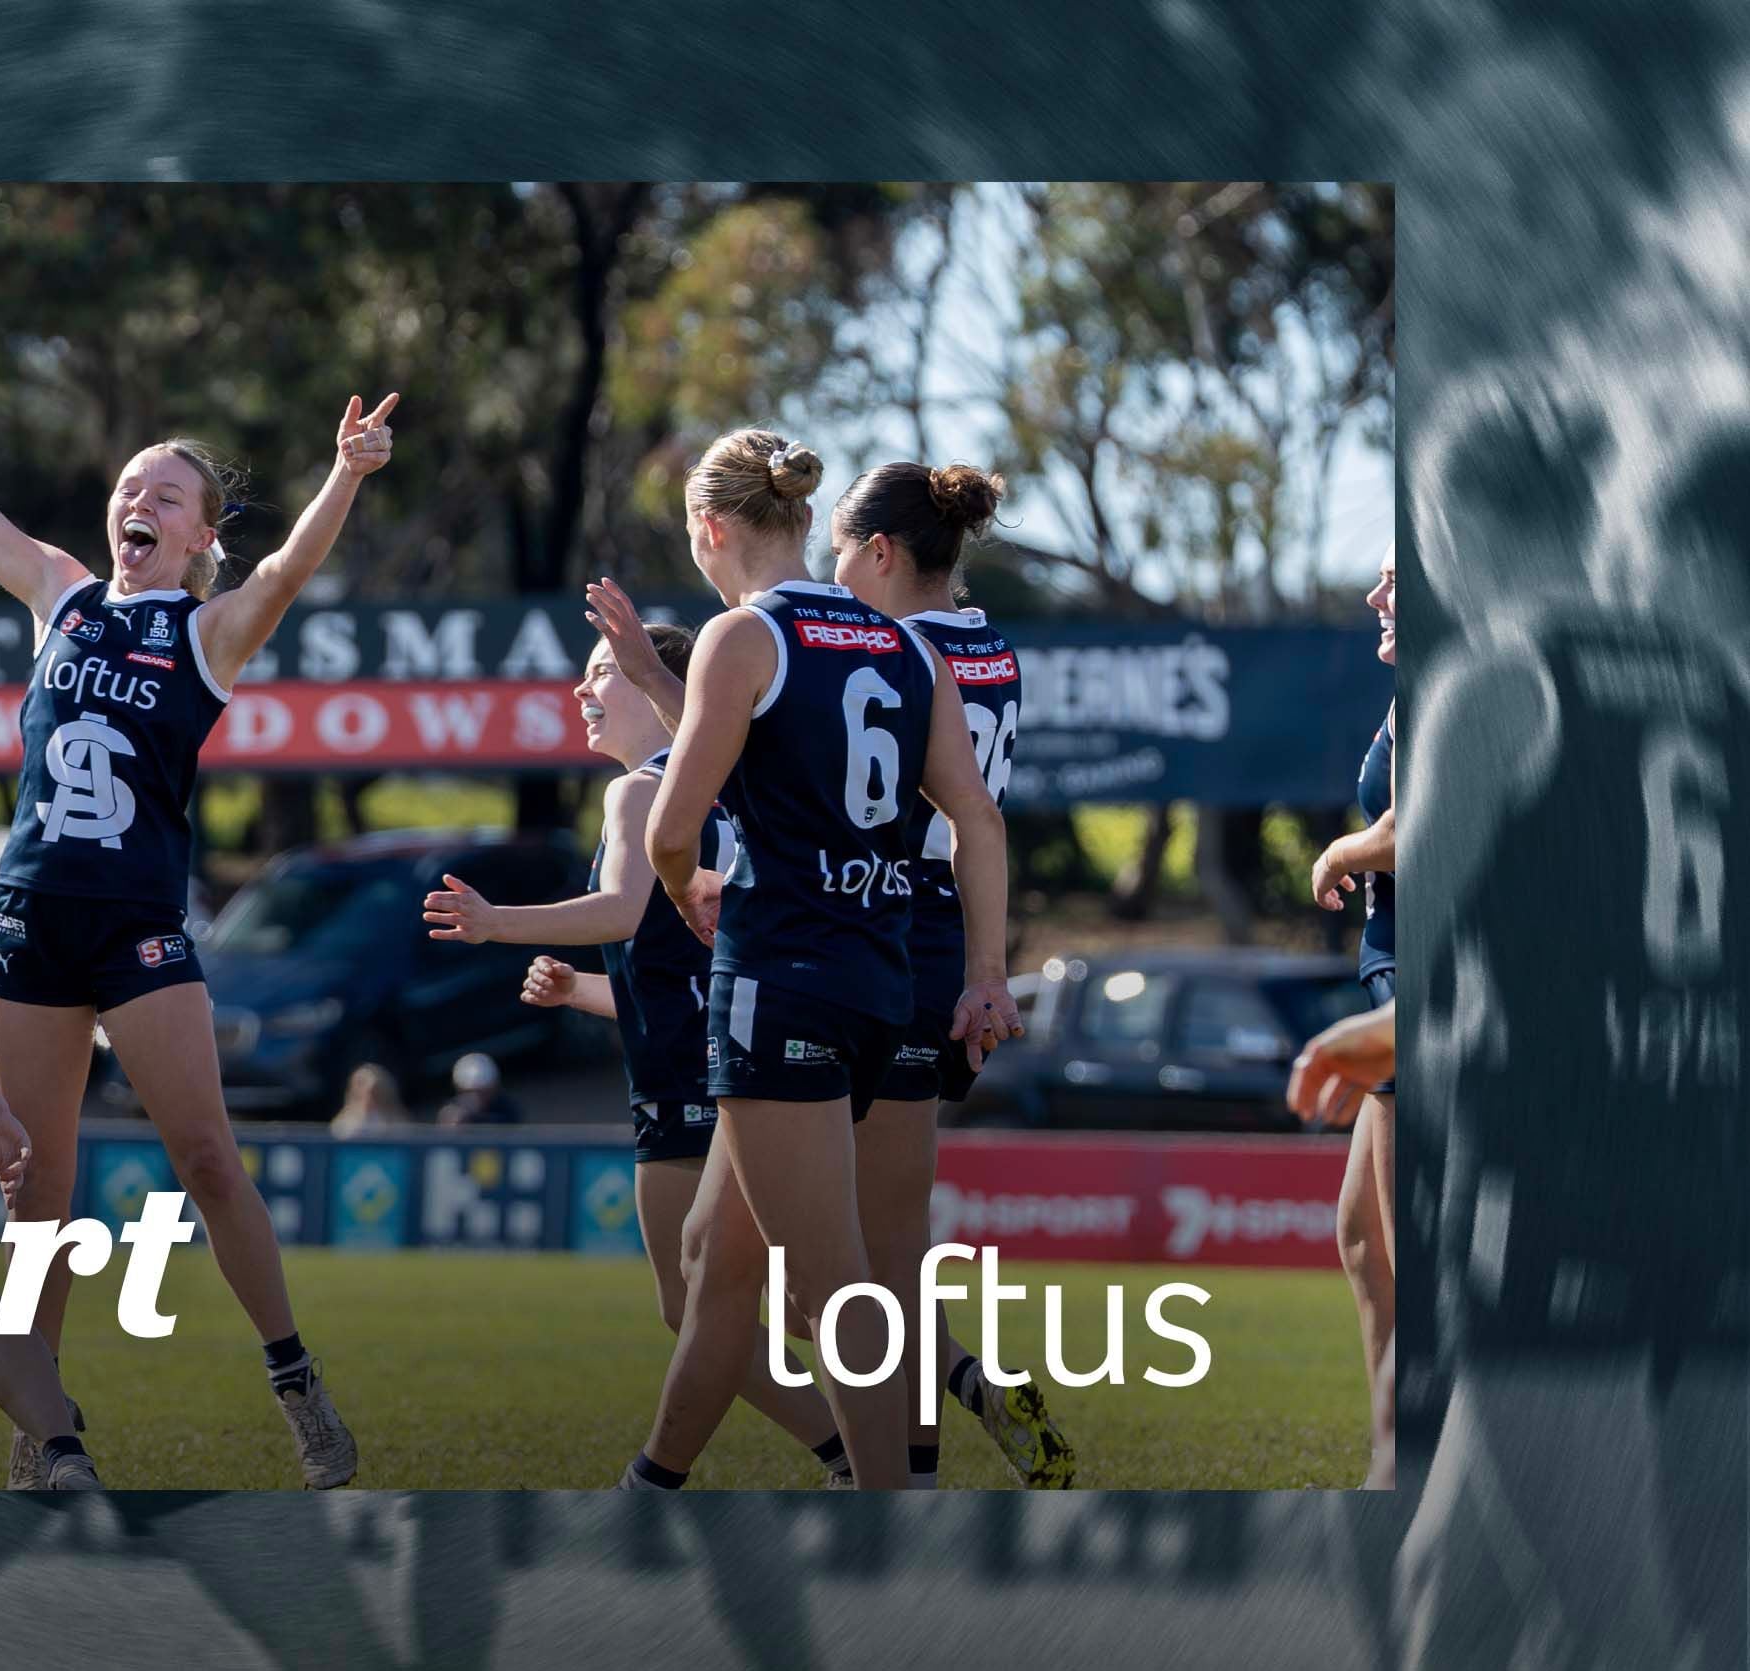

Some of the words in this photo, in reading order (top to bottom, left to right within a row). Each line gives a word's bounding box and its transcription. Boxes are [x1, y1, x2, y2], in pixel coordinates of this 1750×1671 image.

[794, 608, 823, 618] THE
[802, 625, 898, 649] REDARC
[967, 643, 994, 654] POWE
[44, 650, 162, 710] loftus
[842, 666, 902, 830] 6
